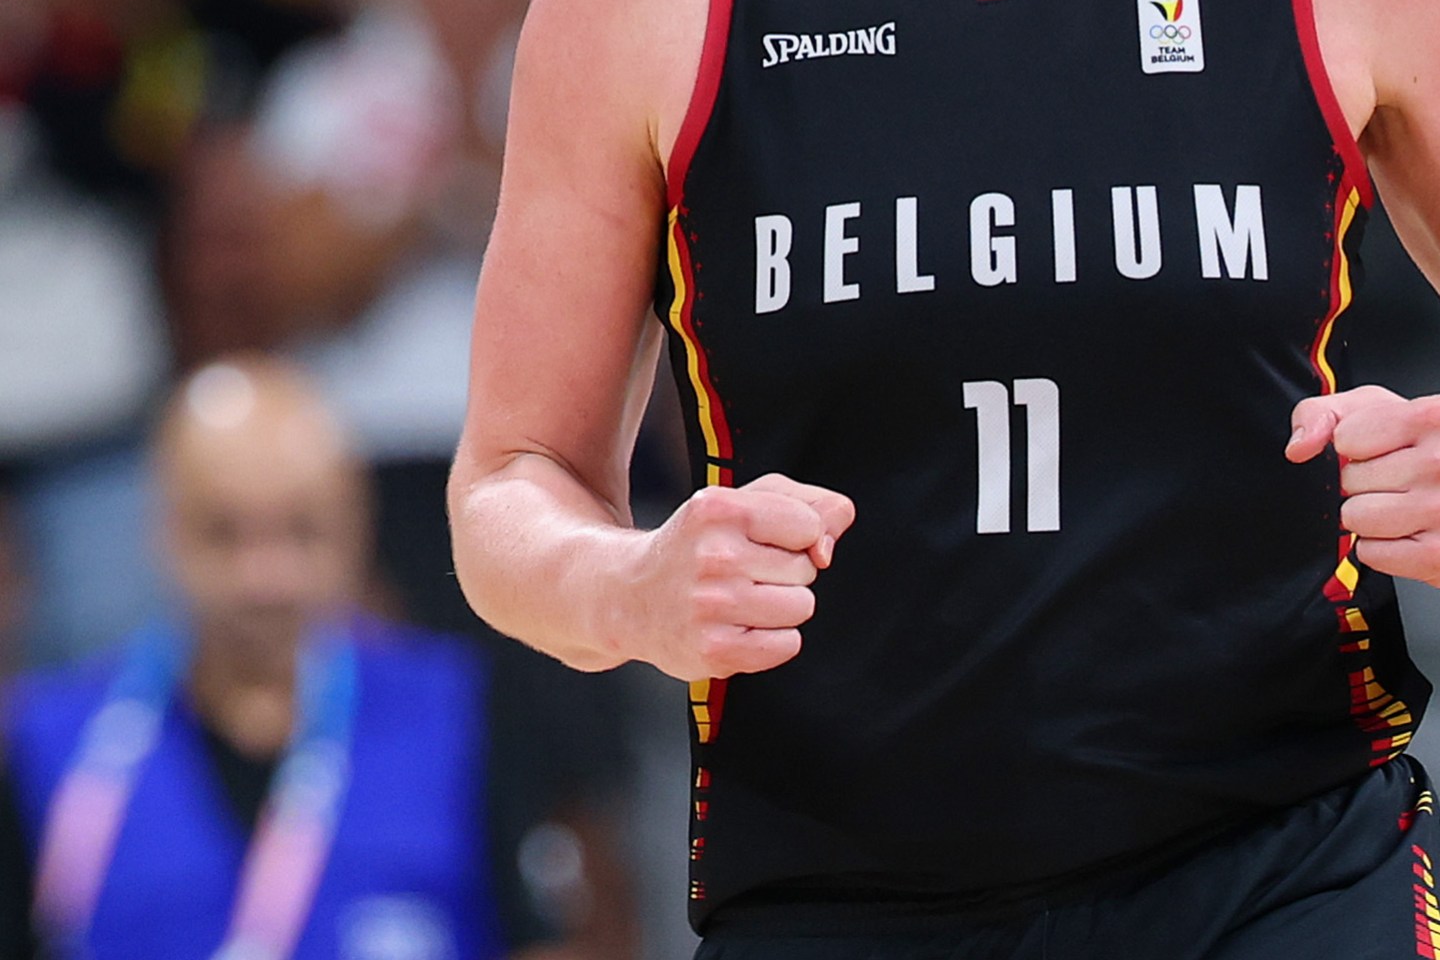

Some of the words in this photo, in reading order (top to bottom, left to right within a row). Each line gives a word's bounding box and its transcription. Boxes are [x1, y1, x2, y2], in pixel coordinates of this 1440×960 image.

[763, 22, 896, 68] SPALDING
[1151, 54, 1195, 64] BELGIUM
[1158, 46, 1186, 55] TEAM
[755, 184, 1269, 315] BELGIUM
[963, 377, 1061, 534] 11
